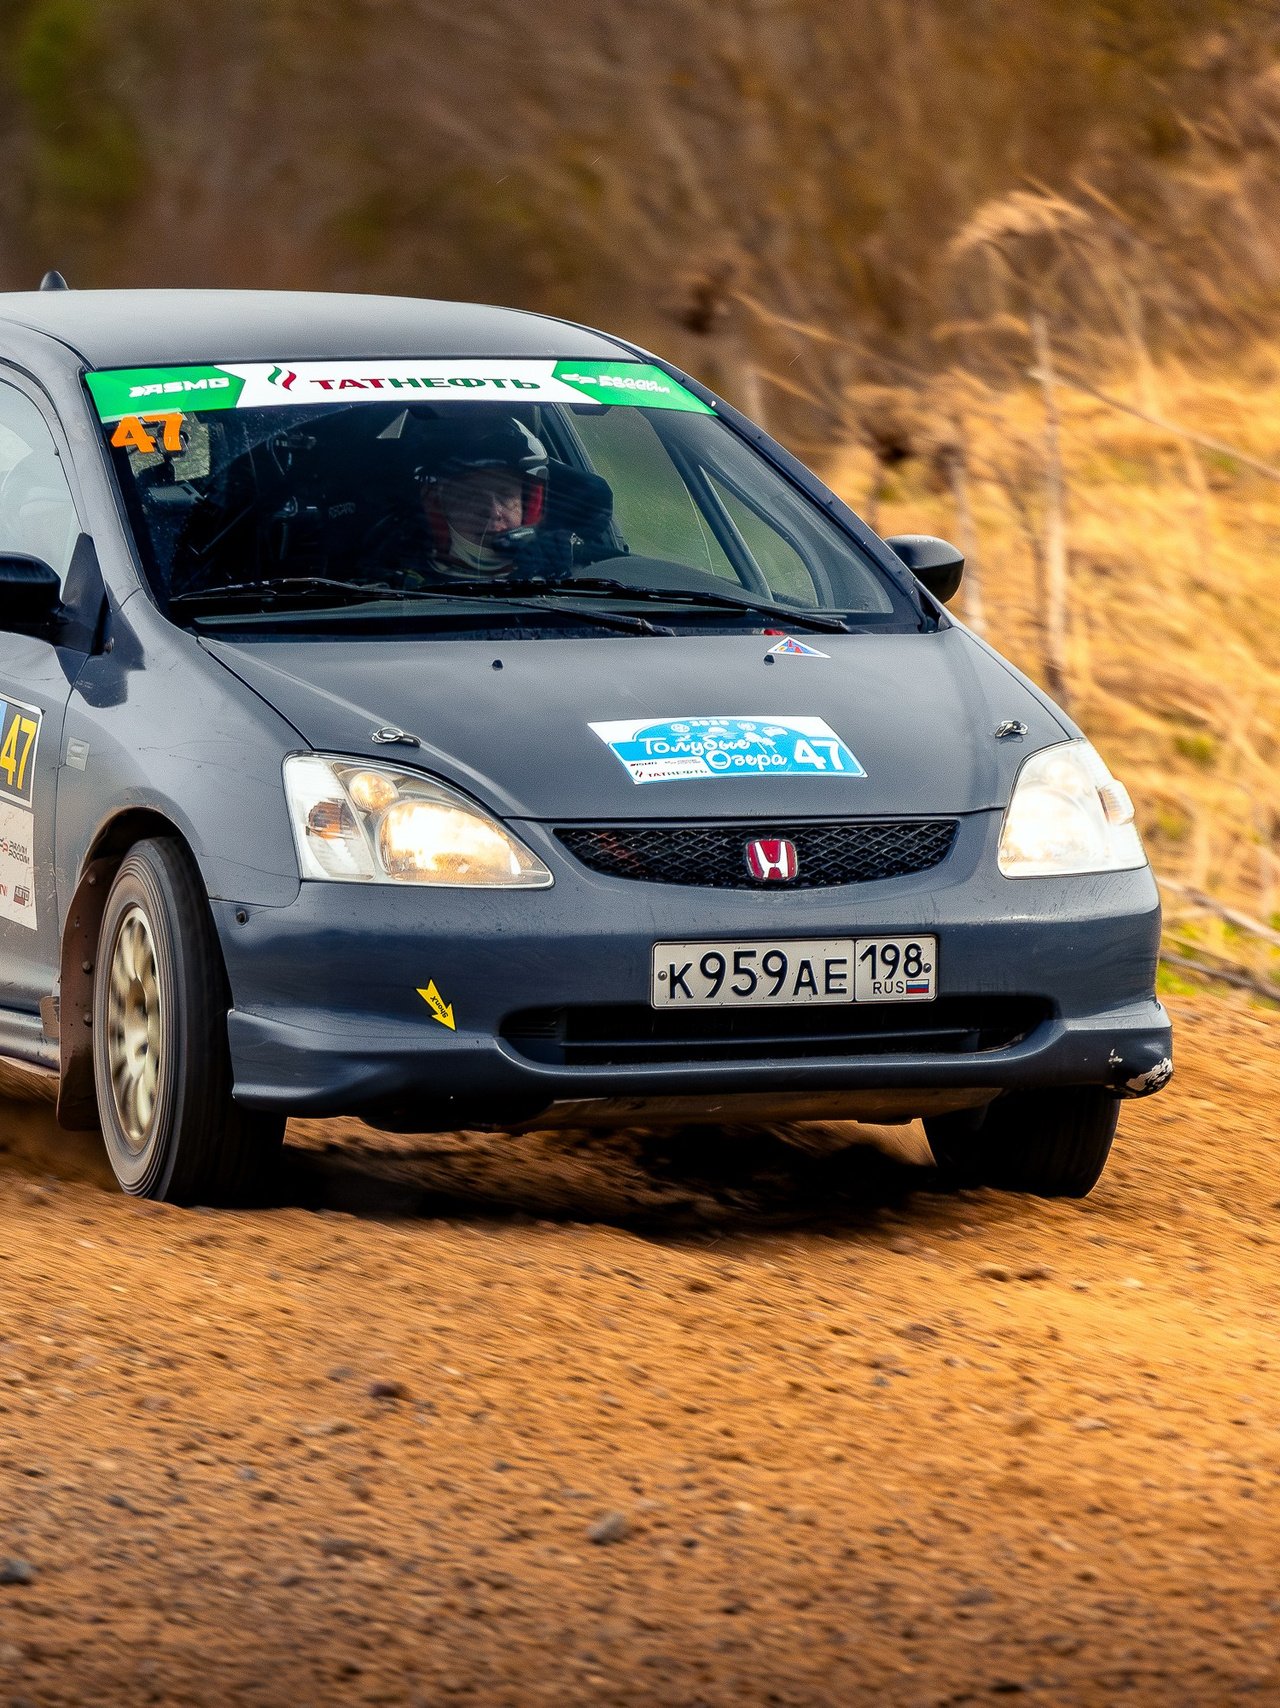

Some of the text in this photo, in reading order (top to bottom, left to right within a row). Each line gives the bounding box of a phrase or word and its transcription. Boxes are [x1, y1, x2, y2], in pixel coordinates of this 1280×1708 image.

[310, 377, 540, 391] ТАТНЕФТЬ
[110, 412, 184, 453] 47
[0, 713, 38, 790] 47
[705, 750, 788, 773] Озера
[793, 739, 841, 771] 47
[859, 942, 924, 980] 198
[873, 980, 905, 995] RUS
